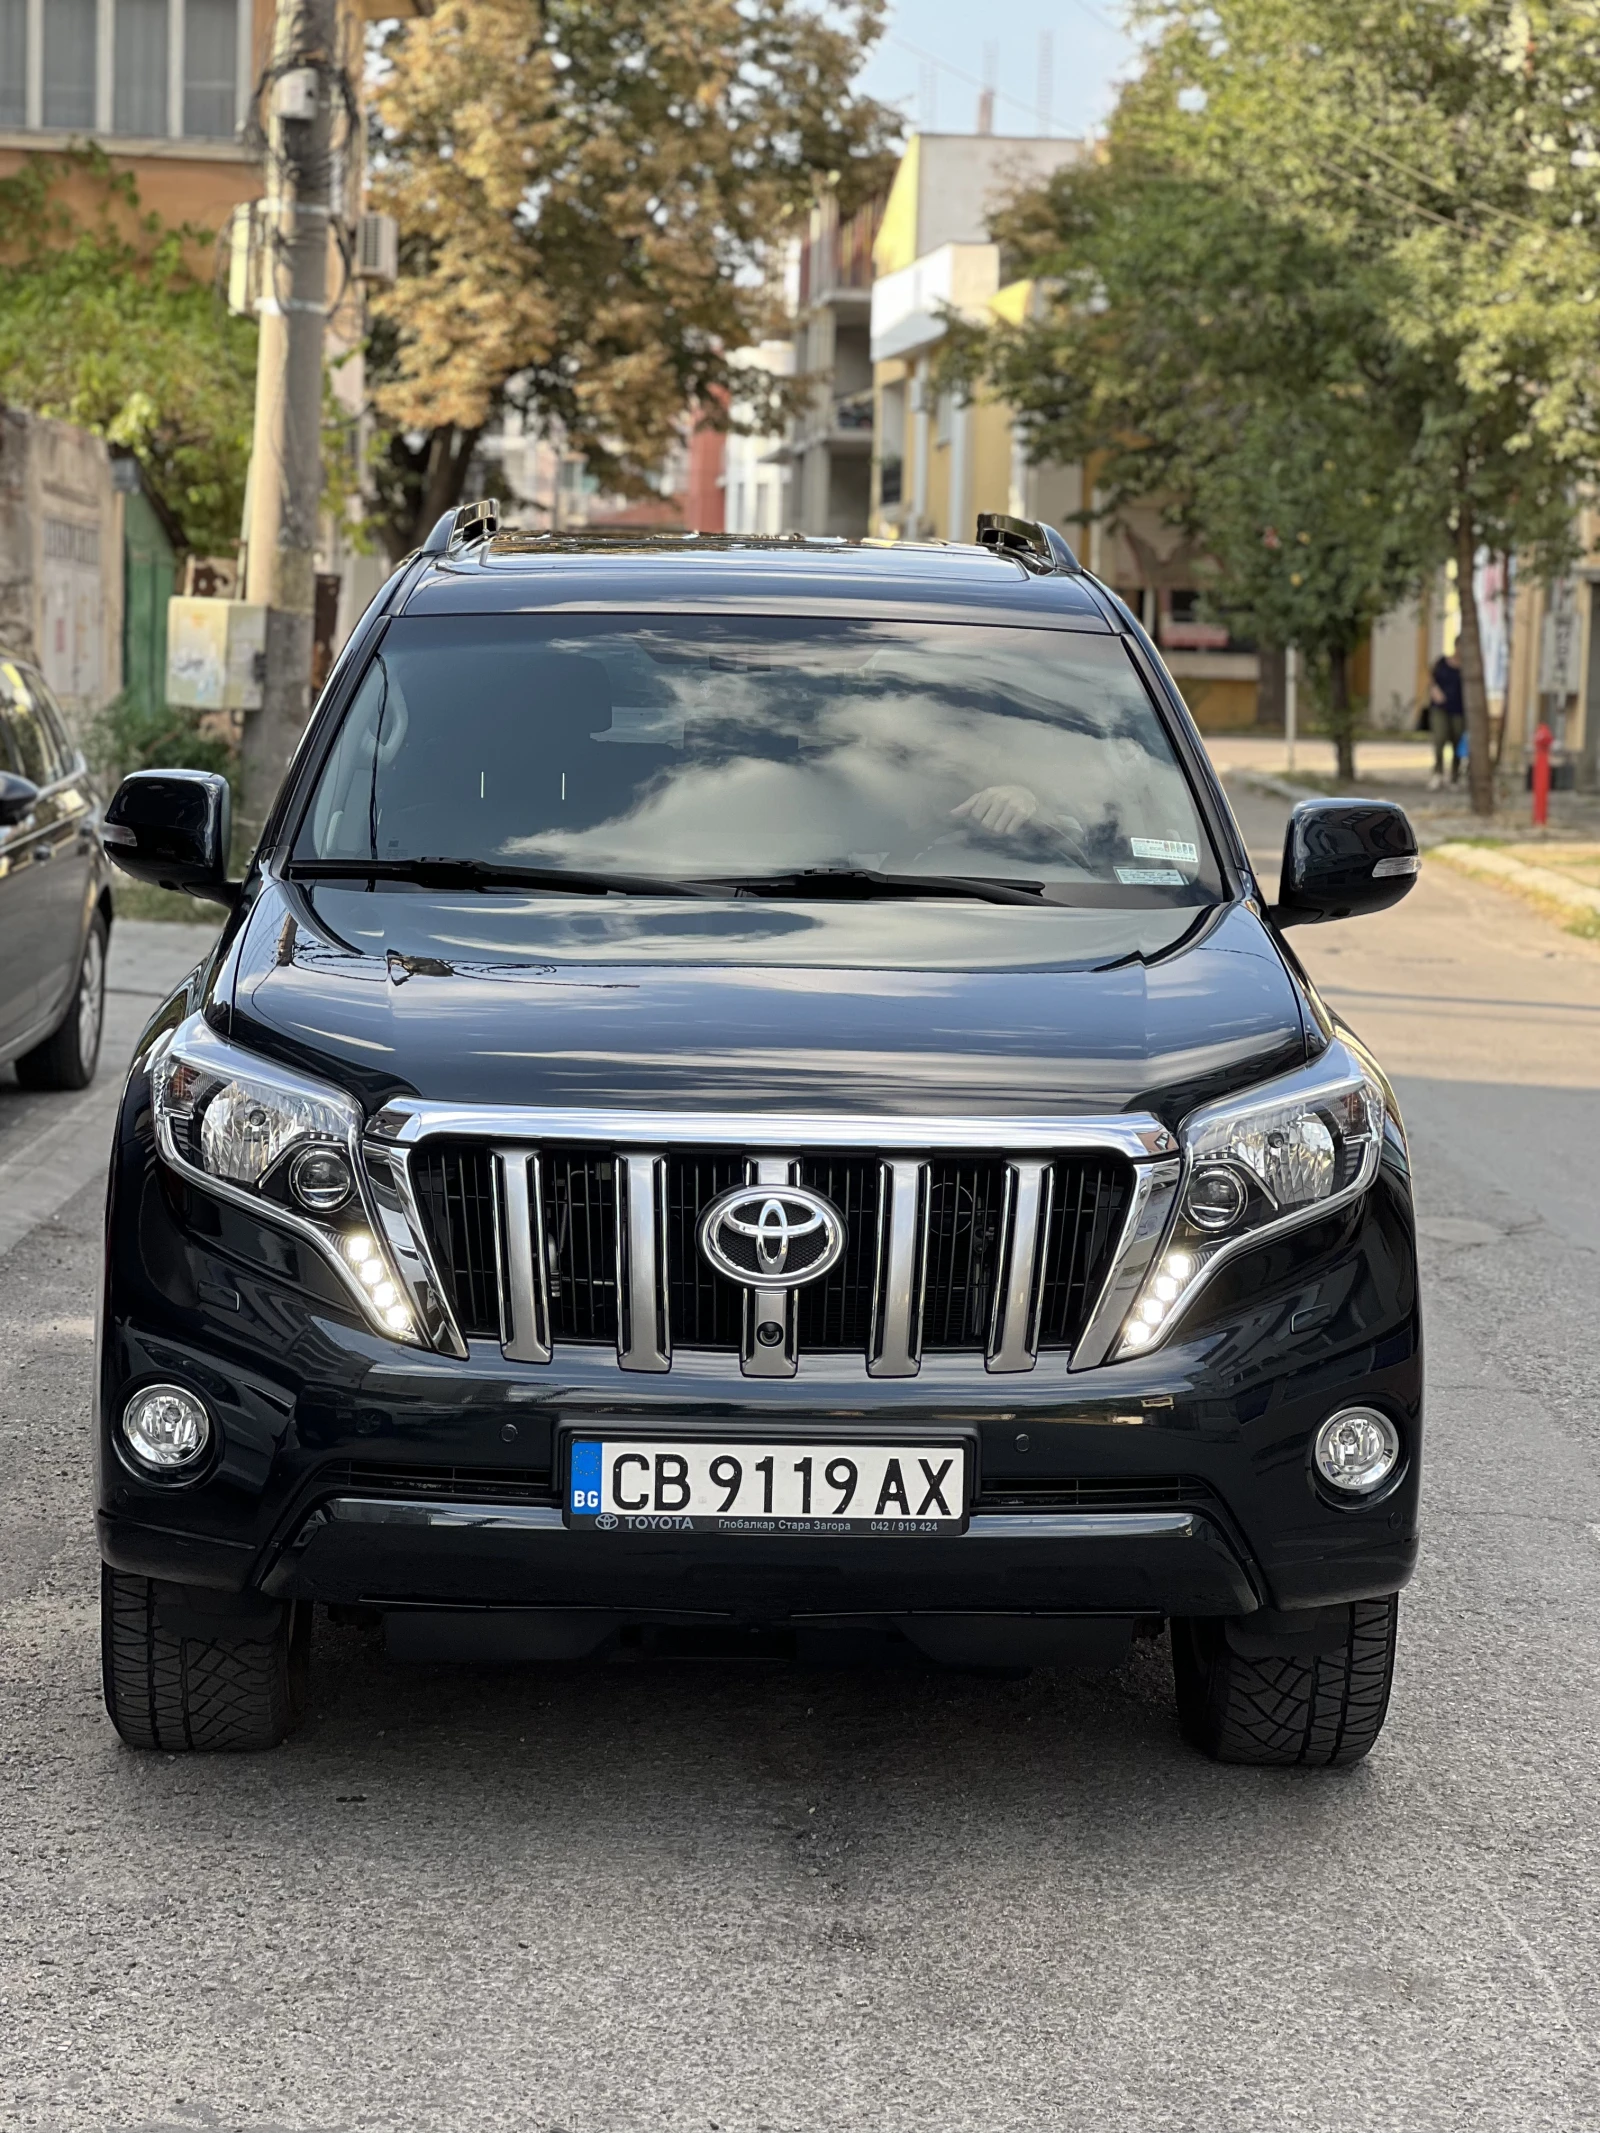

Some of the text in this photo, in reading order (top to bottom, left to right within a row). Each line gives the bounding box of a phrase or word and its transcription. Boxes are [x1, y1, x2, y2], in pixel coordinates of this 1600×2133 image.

[613, 1453, 954, 1515] CB 9119 AX
[574, 1491, 599, 1507] BG
[625, 1516, 694, 1529] TOYOTA
[718, 1519, 851, 1533] Глобалкар Стара Загора
[870, 1521, 889, 1531] 042
[898, 1522, 917, 1531] 919
[919, 1522, 938, 1532] 424
